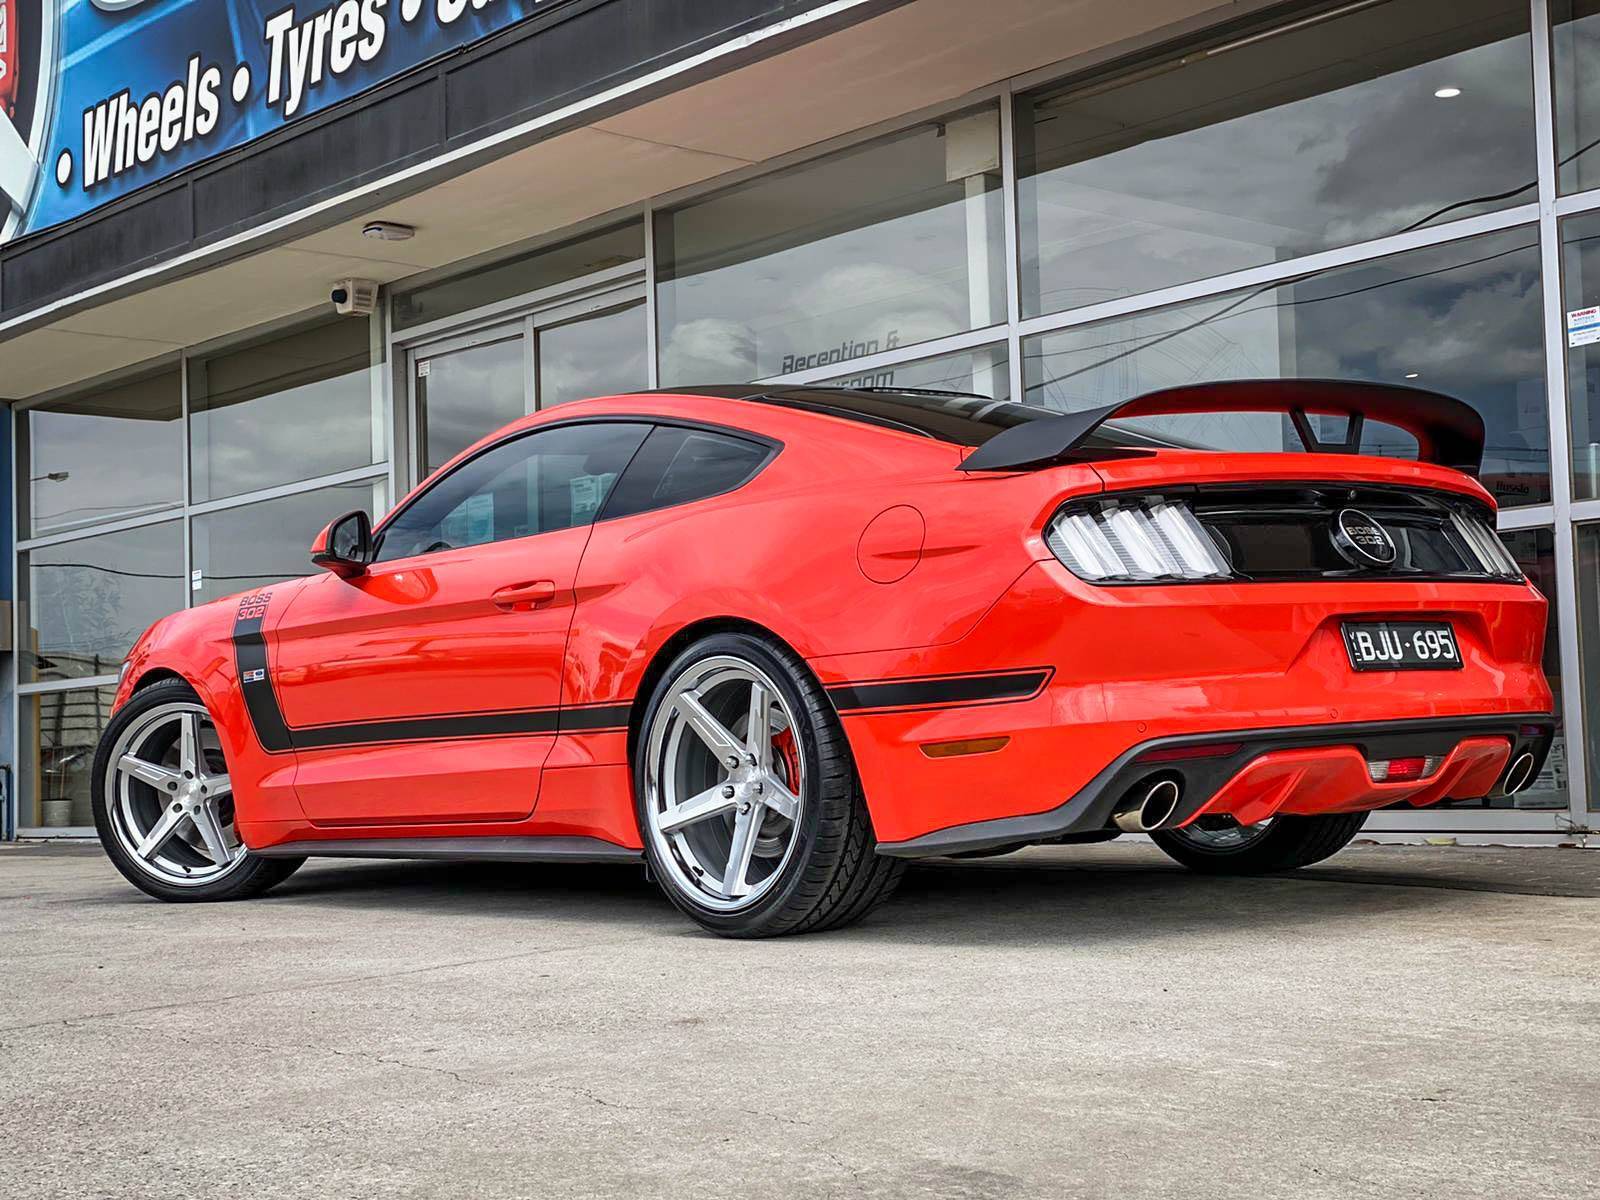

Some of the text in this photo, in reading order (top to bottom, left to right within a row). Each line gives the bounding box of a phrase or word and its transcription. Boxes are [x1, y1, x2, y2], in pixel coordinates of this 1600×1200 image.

[82, 0, 387, 188] Wheels Tyres
[1571, 309, 1597, 318] WARNING
[782, 339, 879, 375] Reception
[1345, 526, 1381, 536] BOSS
[1355, 535, 1385, 545] 302
[240, 592, 273, 607] BOSS
[238, 606, 265, 620] 302
